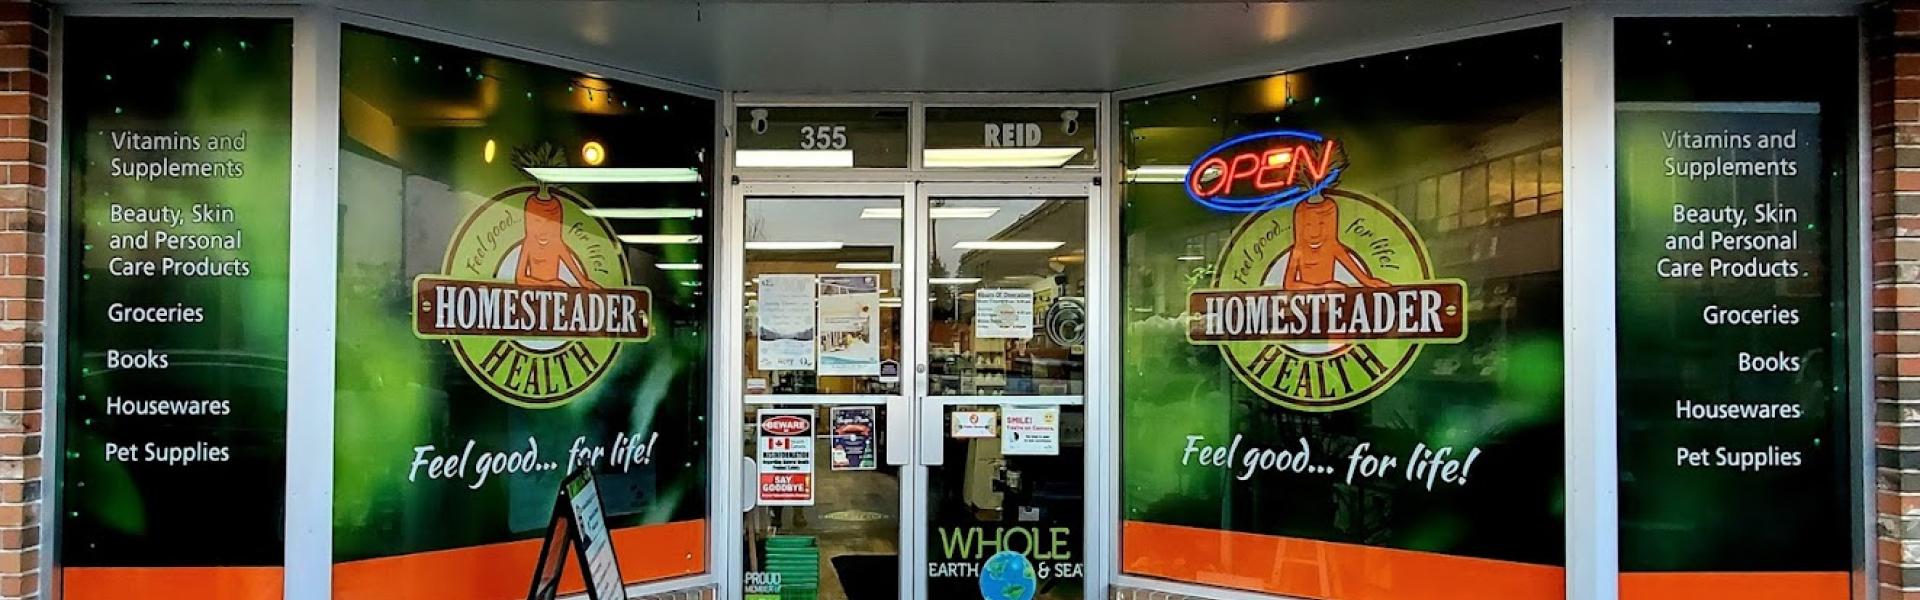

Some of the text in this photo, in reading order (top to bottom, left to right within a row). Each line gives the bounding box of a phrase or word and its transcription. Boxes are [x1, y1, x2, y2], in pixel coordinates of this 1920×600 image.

[111, 130, 246, 150] Vitamins and
[800, 126, 847, 149] 355
[984, 123, 1041, 147] REID
[1662, 129, 1796, 149] Vitamins and
[111, 157, 244, 181] Supplements
[1191, 139, 1335, 198] OPEN
[1665, 156, 1797, 181] Supplements
[111, 203, 234, 227] Beauty, Skin
[1673, 203, 1797, 229] Beauty, Skin
[109, 230, 241, 249] and Personal
[569, 221, 588, 242] for
[1665, 230, 1797, 250] and Personal
[466, 235, 487, 276] Feel
[1344, 217, 1400, 271] for life!
[109, 256, 250, 276] Care Products
[1232, 252, 1254, 286] Feel
[1657, 257, 1798, 277] Care Products
[108, 303, 204, 322] Groceries
[434, 285, 638, 333] HOMESTEADER
[1205, 289, 1444, 336] HOMESTEADER
[1703, 304, 1799, 325] Groceries
[107, 349, 168, 369] Books
[479, 340, 599, 395] HEALTH
[1247, 343, 1389, 398] HEALTH
[1739, 351, 1800, 372] Books
[106, 396, 231, 415] Housewares
[1676, 400, 1801, 419] Housewares
[105, 441, 230, 466] Pet Supplies
[408, 439, 476, 482] Feel
[468, 436, 557, 489] good...
[566, 436, 604, 475] for
[610, 431, 659, 473] life!
[1182, 434, 1481, 492] Feel good... for life!
[1677, 445, 1802, 472] Pet Supplies
[774, 475, 792, 484] SAY
[938, 526, 1071, 560] WHOLE
[745, 572, 782, 584] PROUD
[928, 562, 979, 578] EARTH
[1038, 561, 1049, 579] &
